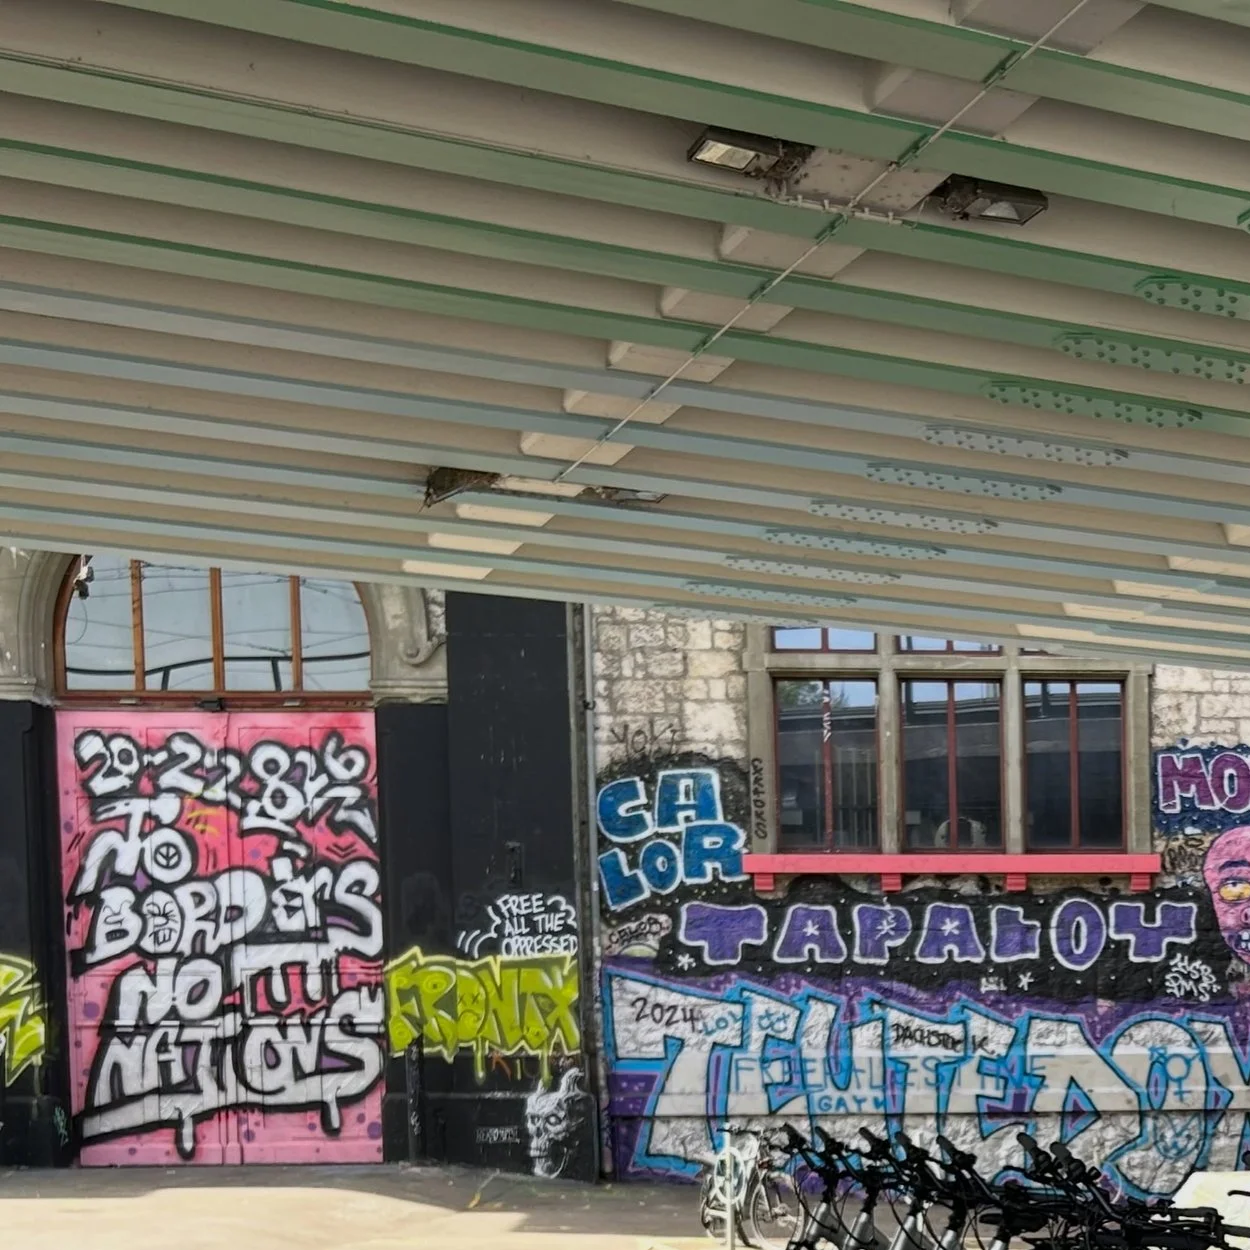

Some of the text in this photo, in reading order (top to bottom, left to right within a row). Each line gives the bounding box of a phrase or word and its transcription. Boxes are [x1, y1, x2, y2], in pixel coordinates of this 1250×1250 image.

[497, 892, 545, 918] FREE
[504, 911, 566, 936] ALL THE
[500, 934, 579, 958] OPPRESSED
[117, 956, 223, 1027] NO
[631, 996, 697, 1033] 2024
[817, 1095, 869, 1113] GAY
